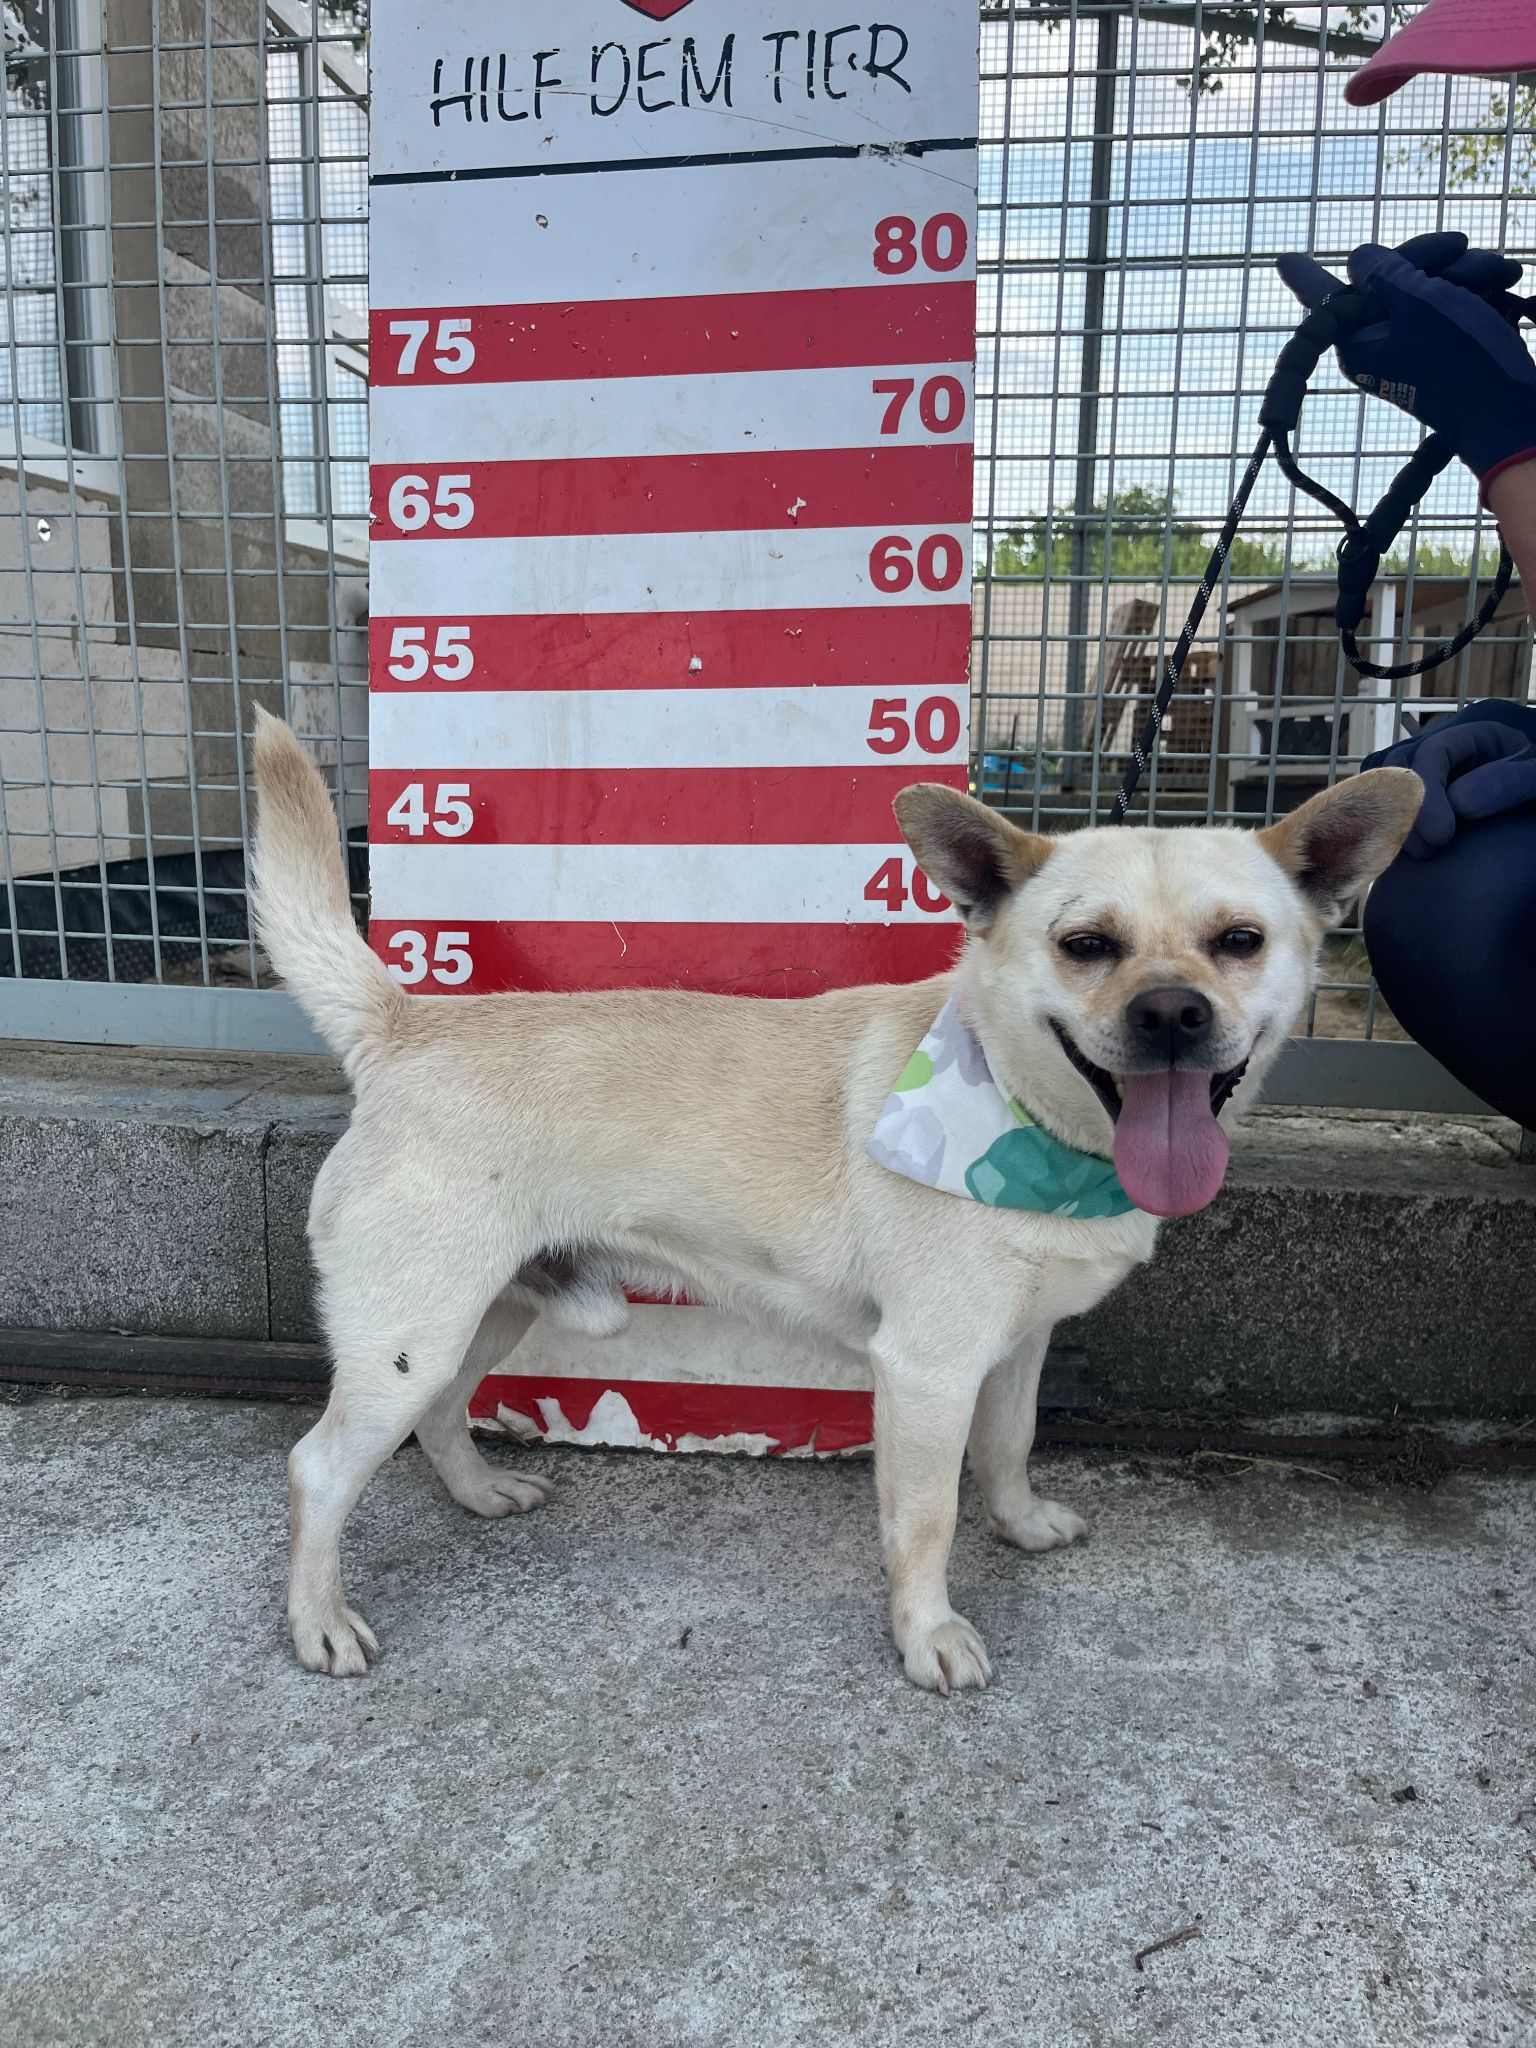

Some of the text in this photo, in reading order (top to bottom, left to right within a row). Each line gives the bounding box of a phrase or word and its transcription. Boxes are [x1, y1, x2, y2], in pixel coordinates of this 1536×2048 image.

[431, 23, 912, 126] HILF DEM TIER
[873, 212, 968, 275] 80
[389, 319, 475, 376] 75
[872, 376, 966, 435] 70
[387, 474, 474, 531] 65
[868, 534, 963, 593] 60
[388, 626, 474, 681] 55
[866, 696, 961, 754] 50
[387, 783, 472, 837] 45
[387, 930, 474, 985] 35
